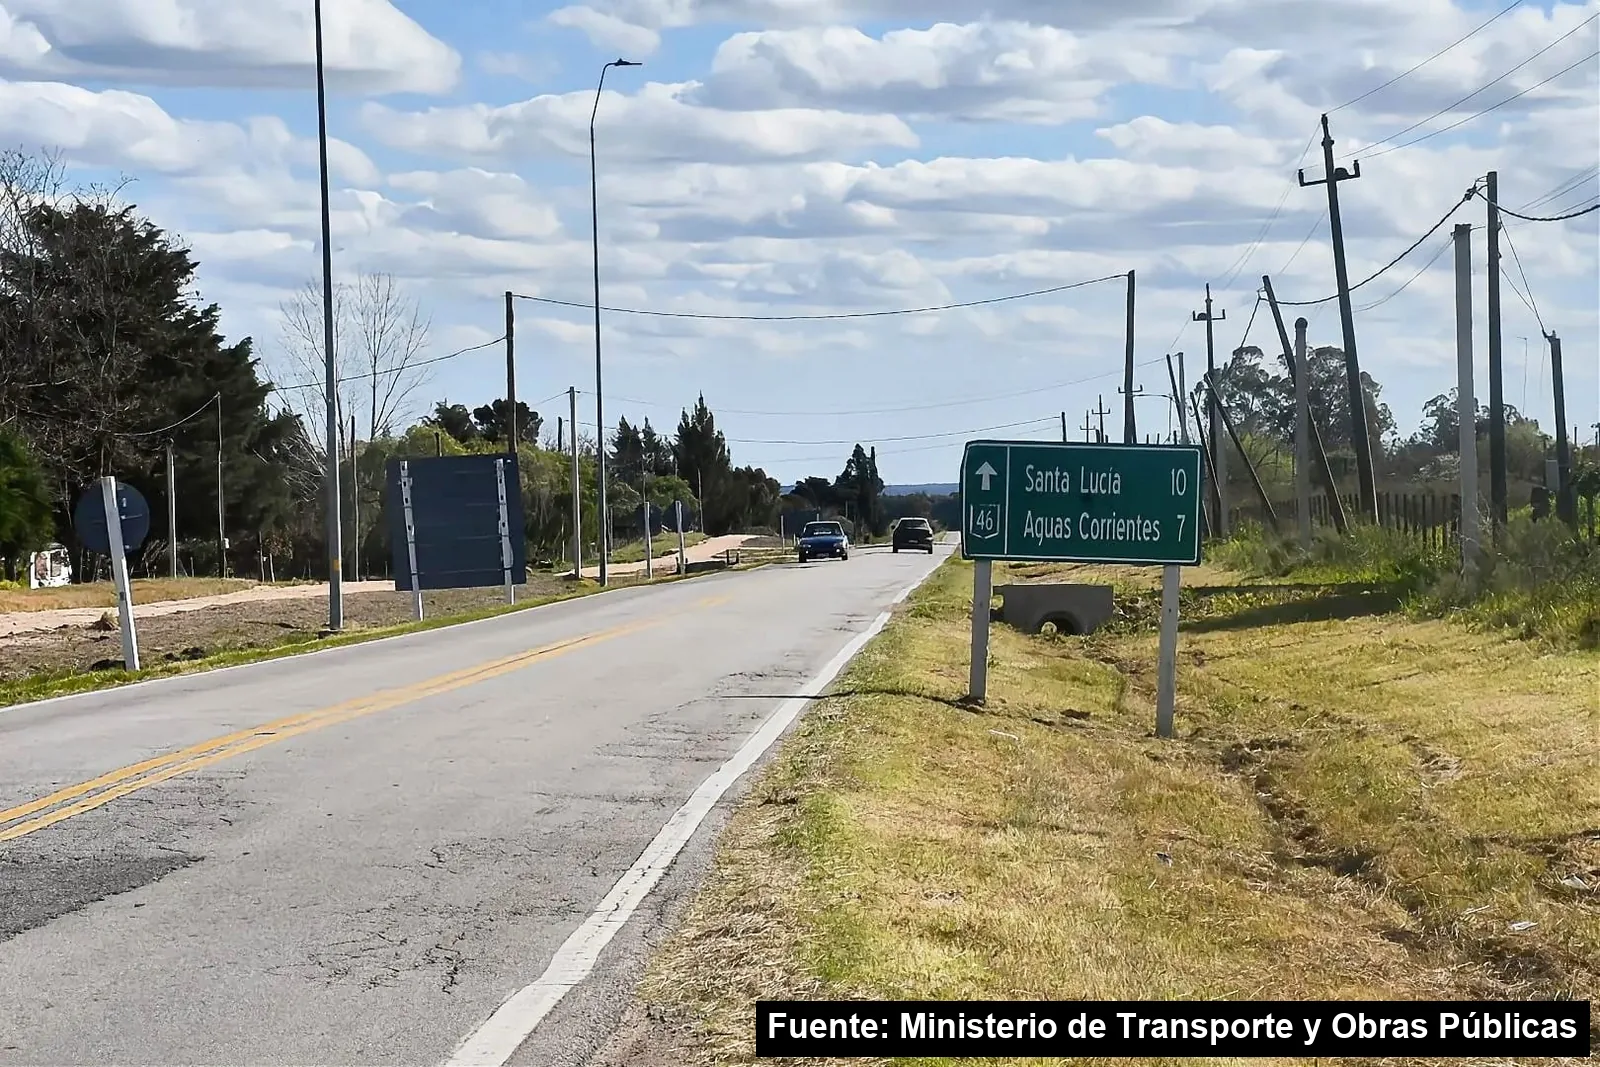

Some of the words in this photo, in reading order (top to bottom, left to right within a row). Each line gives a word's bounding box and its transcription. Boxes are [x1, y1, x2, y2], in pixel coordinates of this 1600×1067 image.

[1025, 464, 1070, 494] Santa
[1080, 465, 1121, 495] Lucía
[1171, 468, 1187, 496] 10
[976, 509, 993, 531] 46
[1023, 510, 1072, 546] Aguas
[1079, 511, 1161, 542] Corrientes
[1176, 514, 1186, 543] 7
